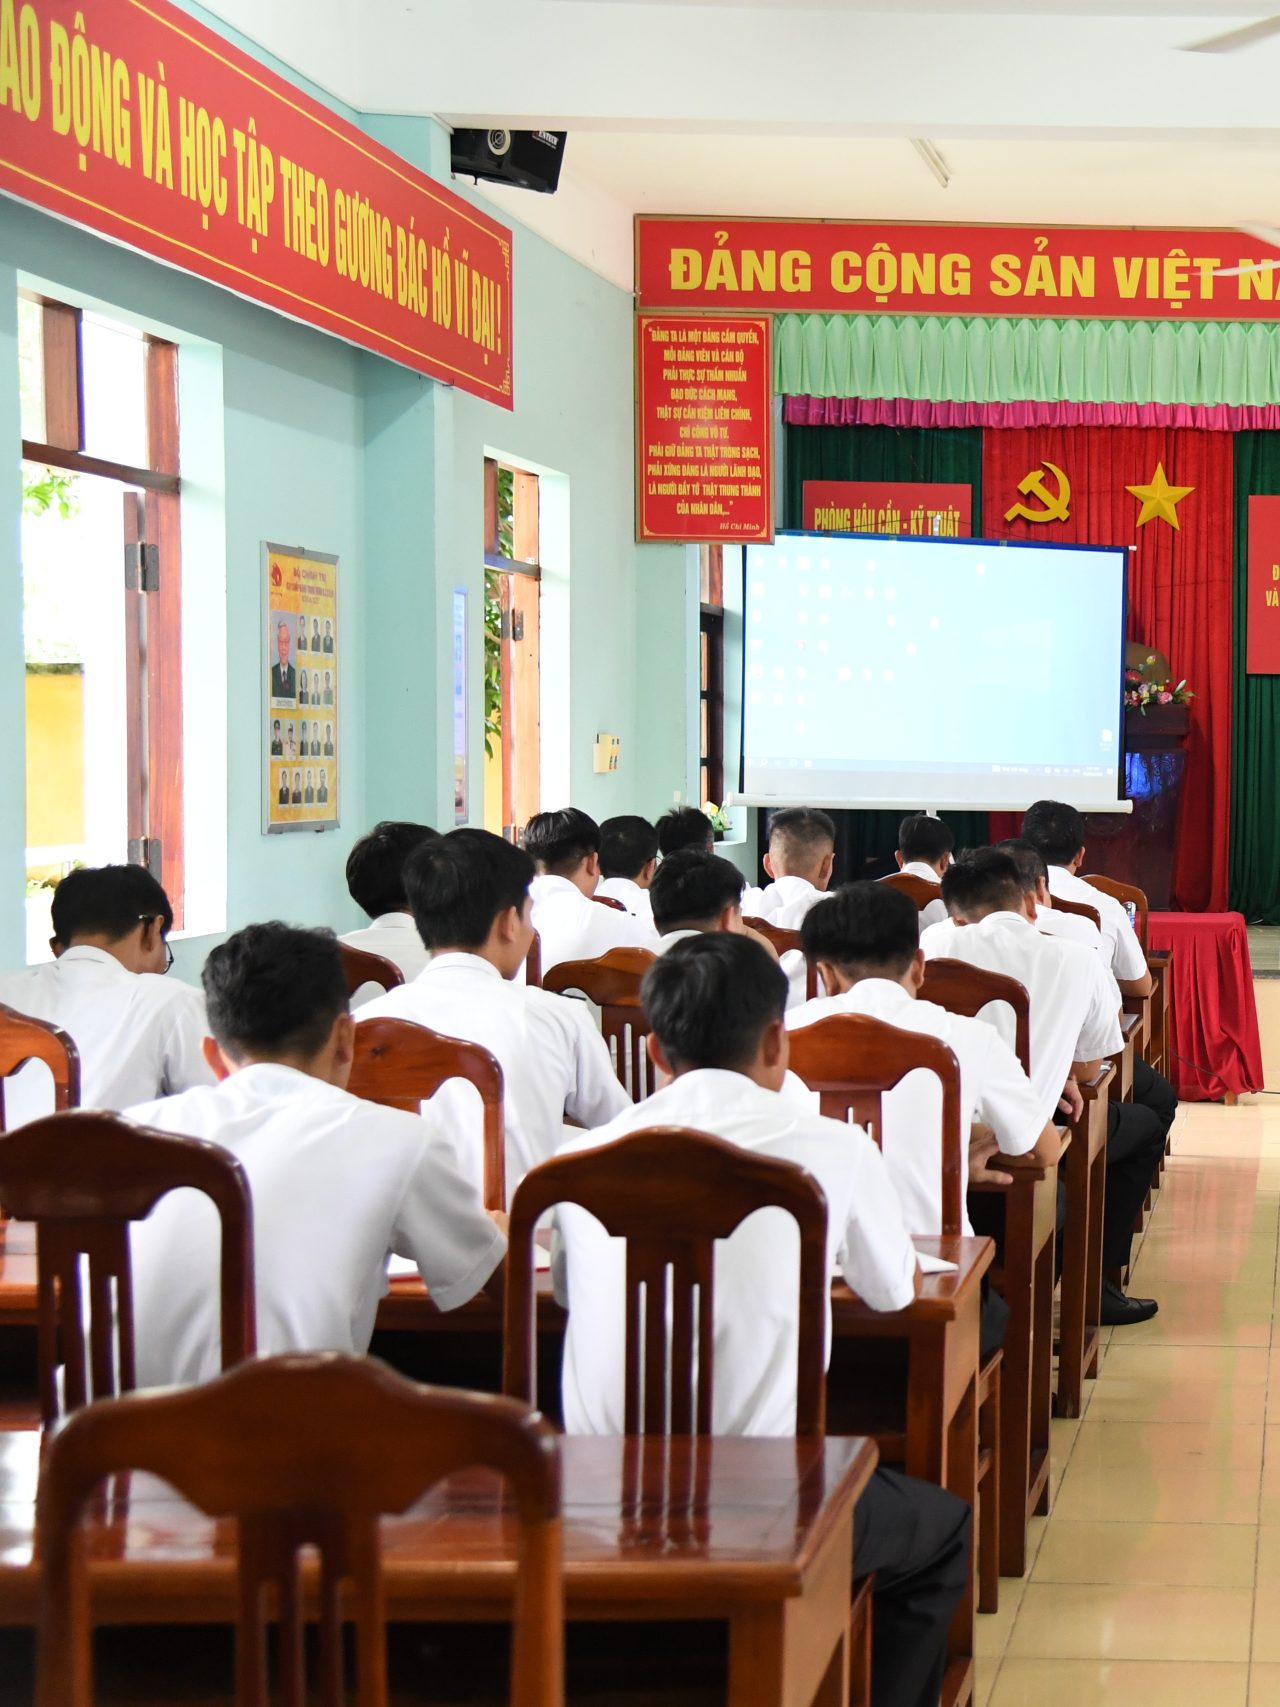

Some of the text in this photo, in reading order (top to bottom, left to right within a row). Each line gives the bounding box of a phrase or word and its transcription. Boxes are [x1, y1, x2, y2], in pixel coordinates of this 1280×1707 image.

[50, 11, 131, 172] ĐỘNG
[138, 61, 173, 190] VÀ
[179, 96, 228, 230] HỌC
[233, 116, 275, 254] TẬP
[280, 155, 330, 268] THEO
[334, 188, 393, 300] GƯƠNG
[397, 216, 428, 319] BÁC
[432, 226, 452, 330] HỒ
[455, 248, 469, 339] VĨ
[472, 269, 495, 366] ĐẠI
[669, 231, 812, 292] ĐẢNG
[830, 243, 971, 302] CỘNG
[989, 237, 1096, 298] SẢN
[1113, 248, 1221, 309] VIỆT
[1266, 587, 1279, 607] VÀ
